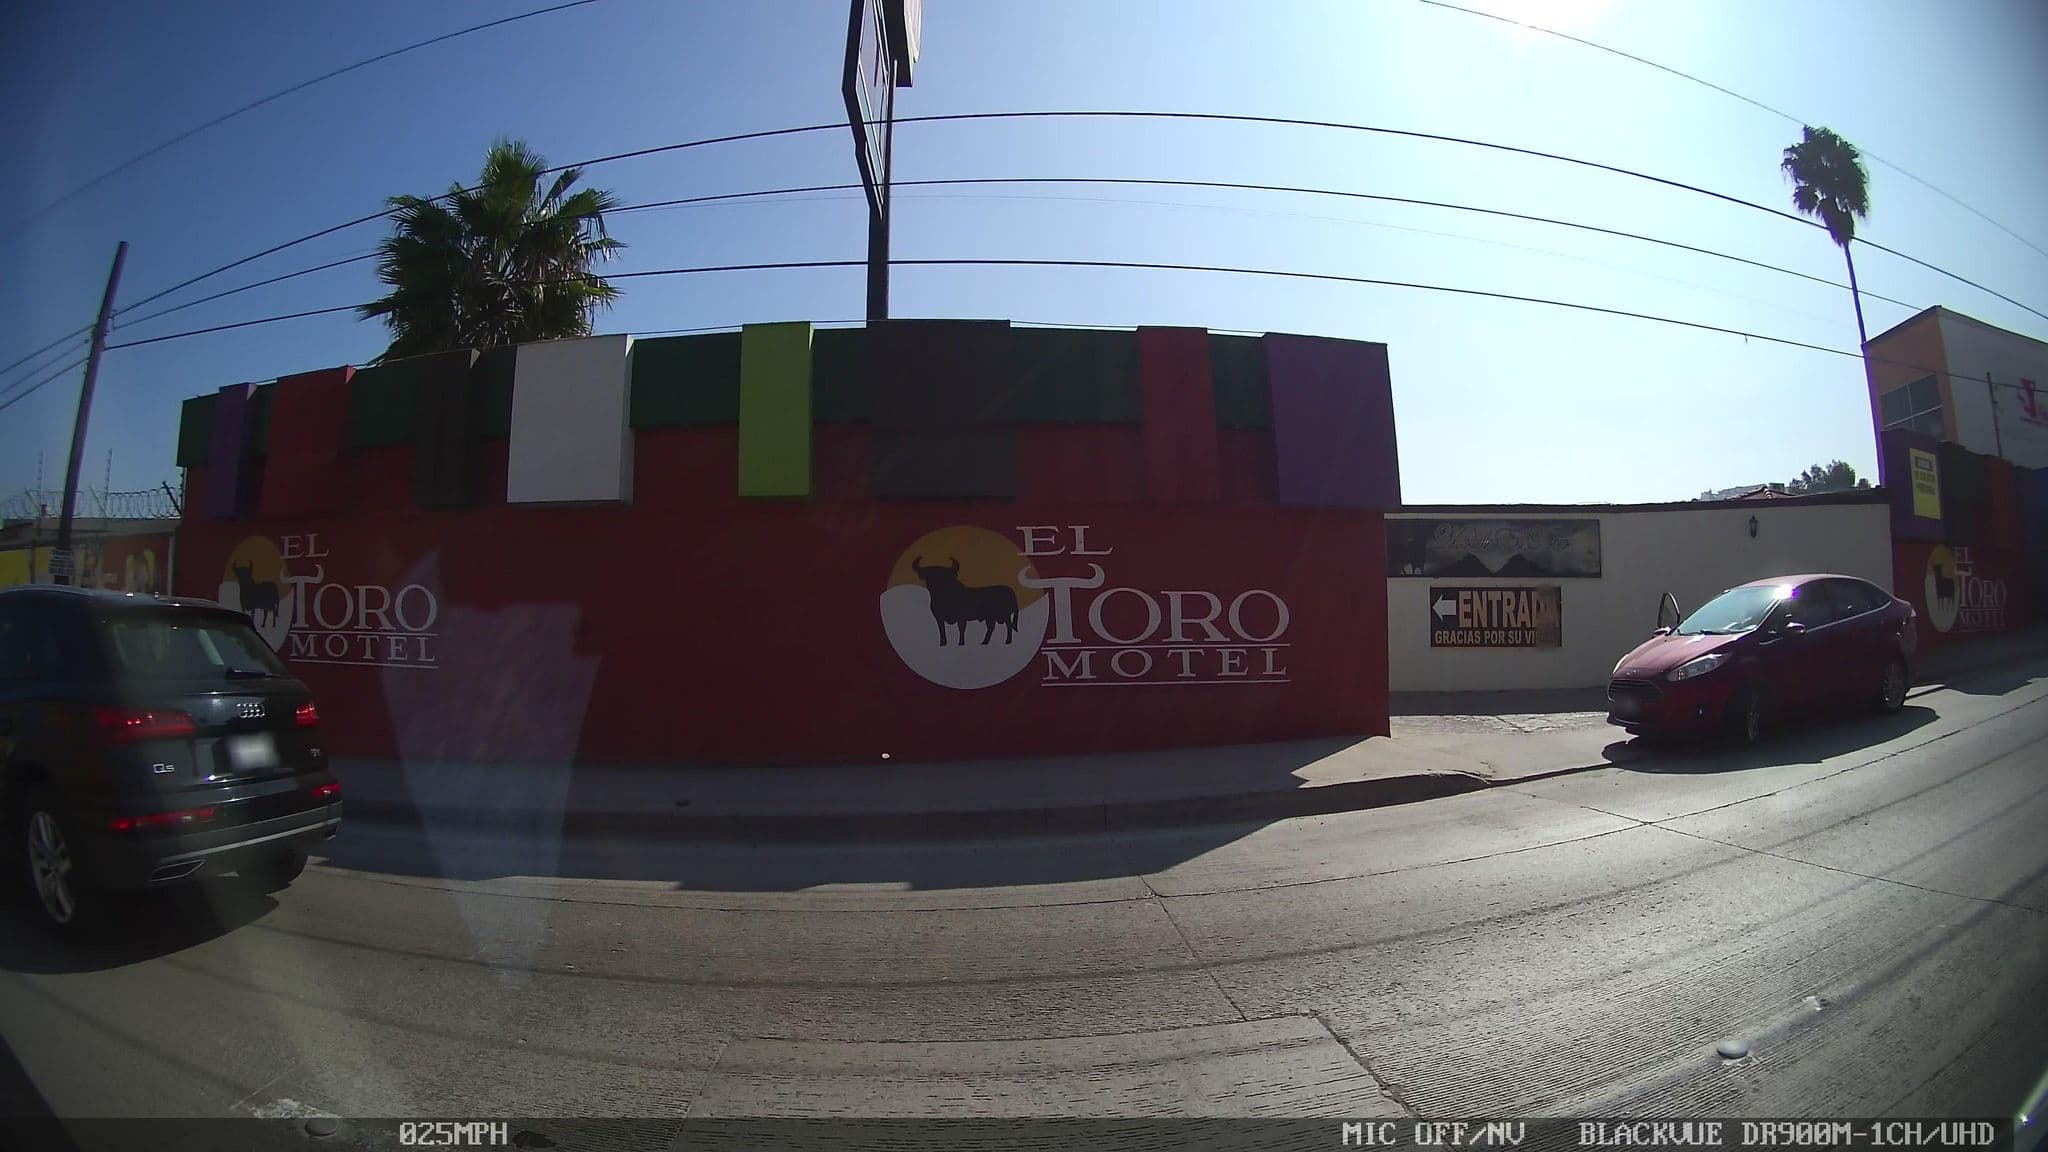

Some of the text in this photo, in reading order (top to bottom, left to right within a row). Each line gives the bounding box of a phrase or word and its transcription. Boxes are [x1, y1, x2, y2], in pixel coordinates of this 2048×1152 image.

[280, 533, 330, 559] EL
[1017, 525, 1113, 556] EL
[280, 563, 438, 632] TORO
[1017, 563, 1290, 645] TORO
[290, 633, 436, 663] MOTEL
[1434, 630, 1481, 645] GRACIAS
[1484, 630, 1506, 645] POR
[1507, 630, 1522, 645] SU
[1041, 648, 1287, 681] MOTEL
